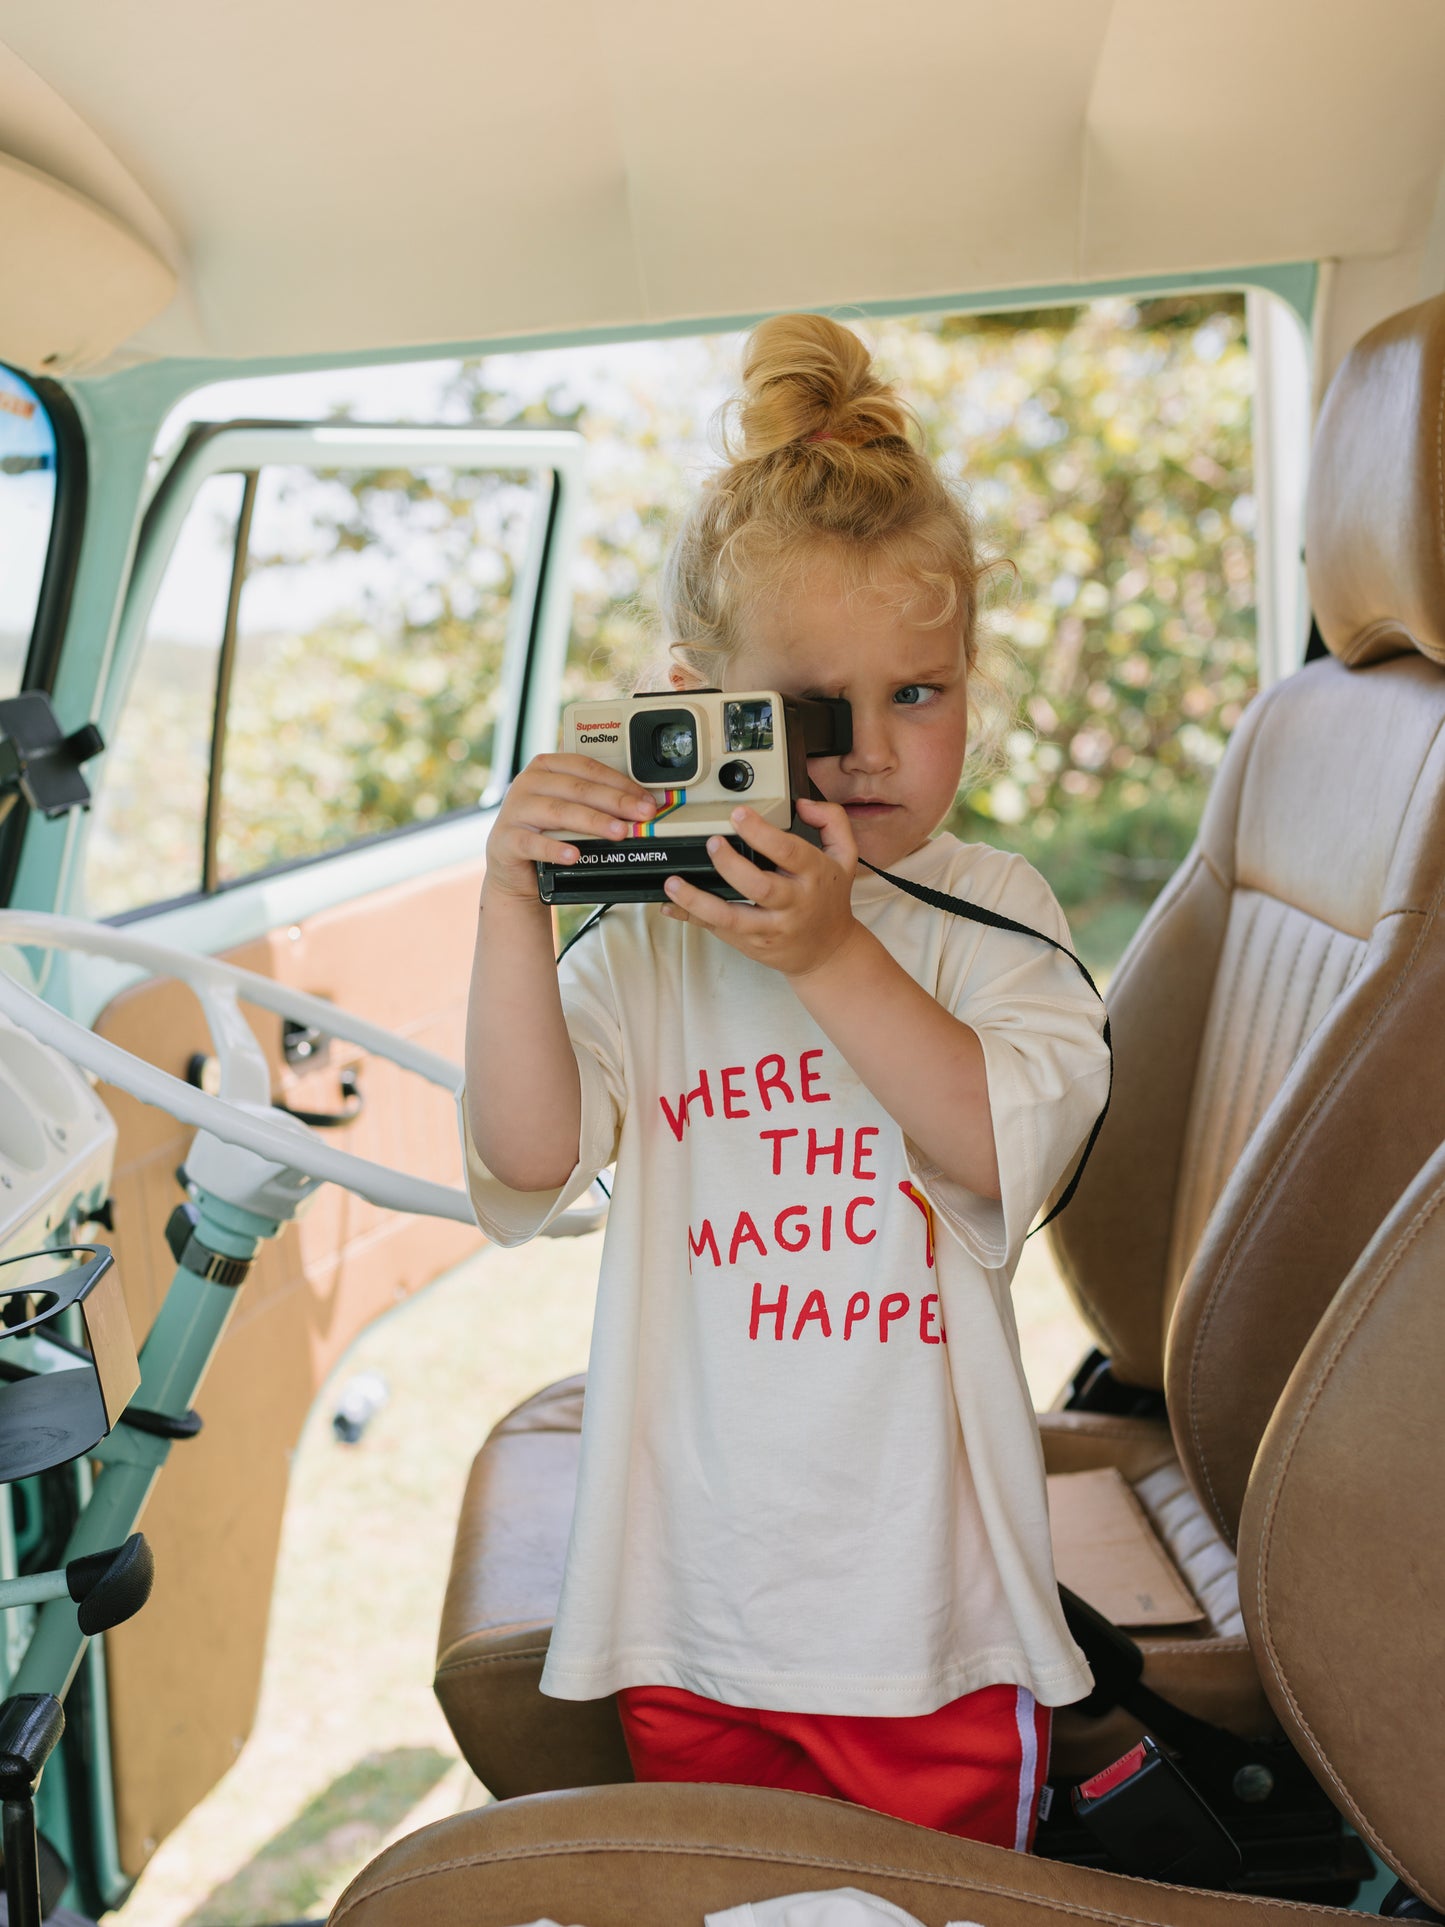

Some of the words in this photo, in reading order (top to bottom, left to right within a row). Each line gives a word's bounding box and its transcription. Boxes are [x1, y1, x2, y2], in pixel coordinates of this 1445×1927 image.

[576, 721, 621, 732] Supercolor
[580, 734, 618, 743] OneStep
[600, 853, 625, 863] LAND
[627, 851, 668, 862] CAMERA
[760, 1127, 879, 1180] THE
[688, 1196, 877, 1275] MAGIC
[750, 1282, 947, 1344] HAPPE
